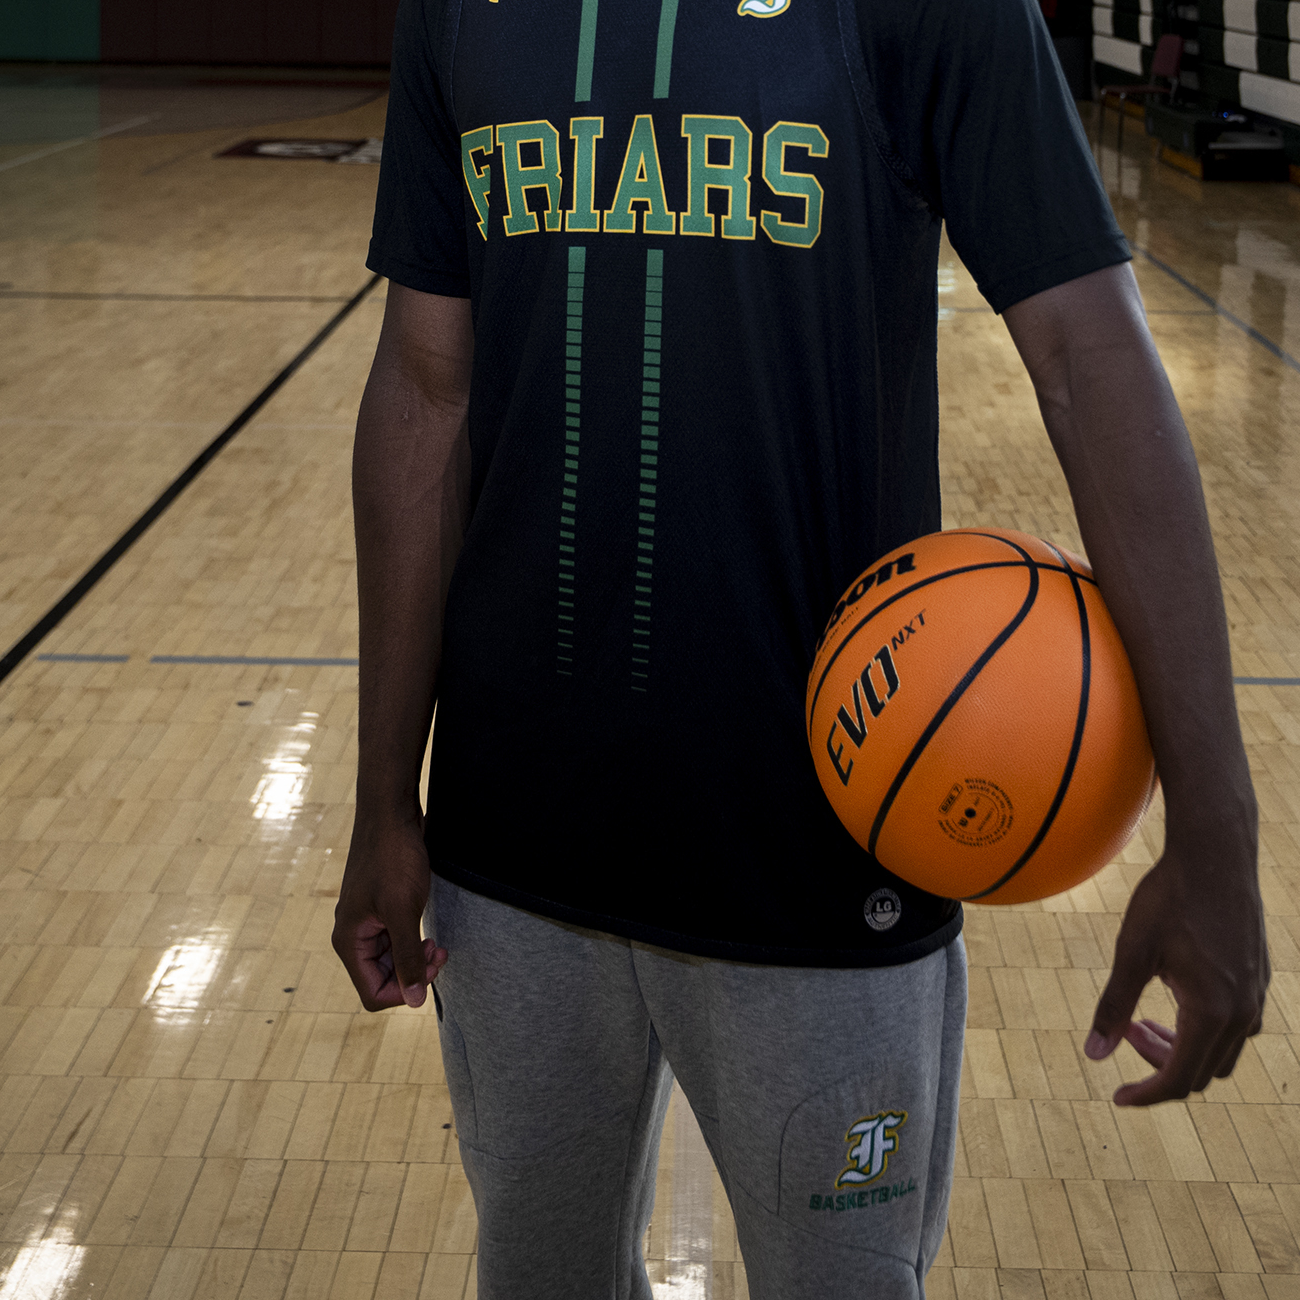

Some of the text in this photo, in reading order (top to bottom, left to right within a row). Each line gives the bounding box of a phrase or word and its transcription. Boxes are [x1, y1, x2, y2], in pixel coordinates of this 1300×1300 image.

[460, 113, 830, 249] FRIARS
[827, 608, 926, 787] EVO NXT
[940, 794, 956, 812] SIZE
[875, 900, 892, 912] LG
[808, 1177, 916, 1212] BASKETBALL
